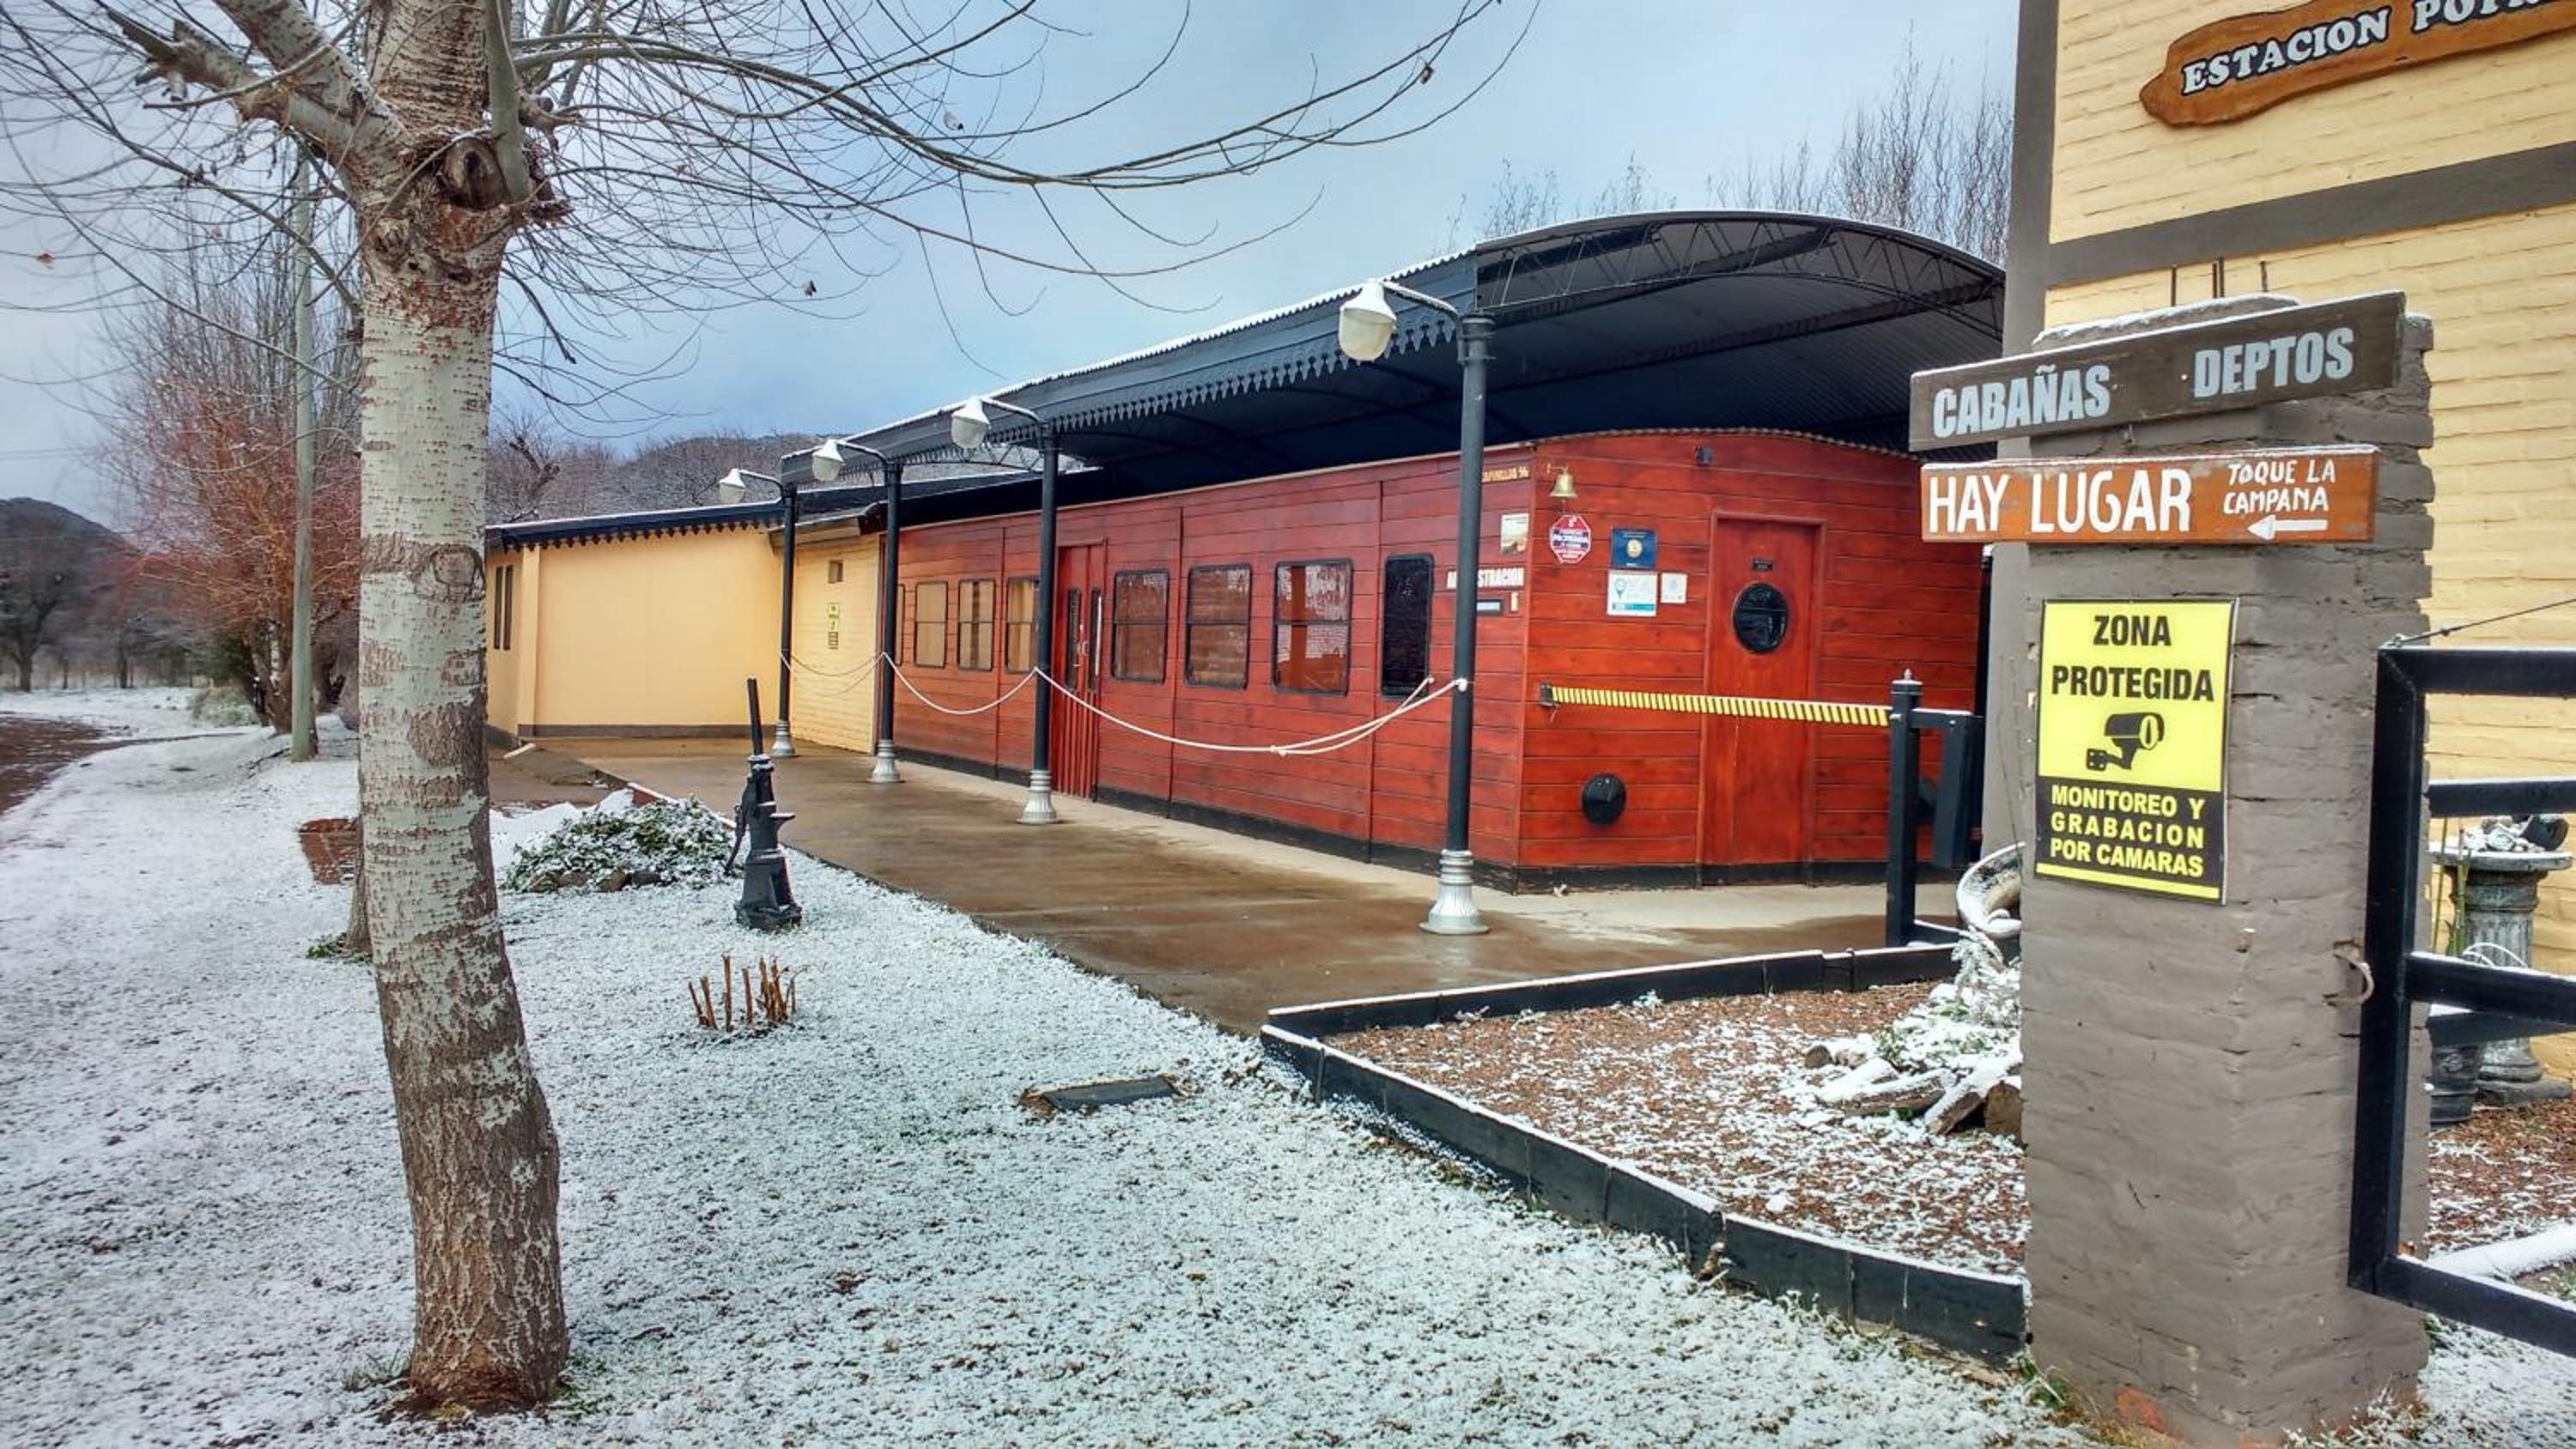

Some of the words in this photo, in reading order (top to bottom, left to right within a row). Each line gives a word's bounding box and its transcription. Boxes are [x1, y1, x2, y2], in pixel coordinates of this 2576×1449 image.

[2182, 8, 2391, 94] ESTACION
[2412, 0, 2539, 32] PO
[1932, 363, 2111, 439] CABAÑAS
[2194, 326, 2354, 399] DEPTOS
[2228, 459, 2298, 487] TOQUE
[2306, 458, 2336, 484] LA
[1929, 472, 2009, 533] HAY
[2030, 468, 2192, 533] LUGAR
[2223, 486, 2330, 514] CAMPANA
[2093, 615, 2172, 646] ZONA
[2051, 665, 2215, 701] PROTEGIDA
[2051, 784, 2178, 817] MONITOREO
[2189, 797, 2205, 820] Y
[2051, 812, 2204, 849] GRABACION
[2050, 838, 2091, 863] POR
[2096, 845, 2204, 877] CAMARAS
